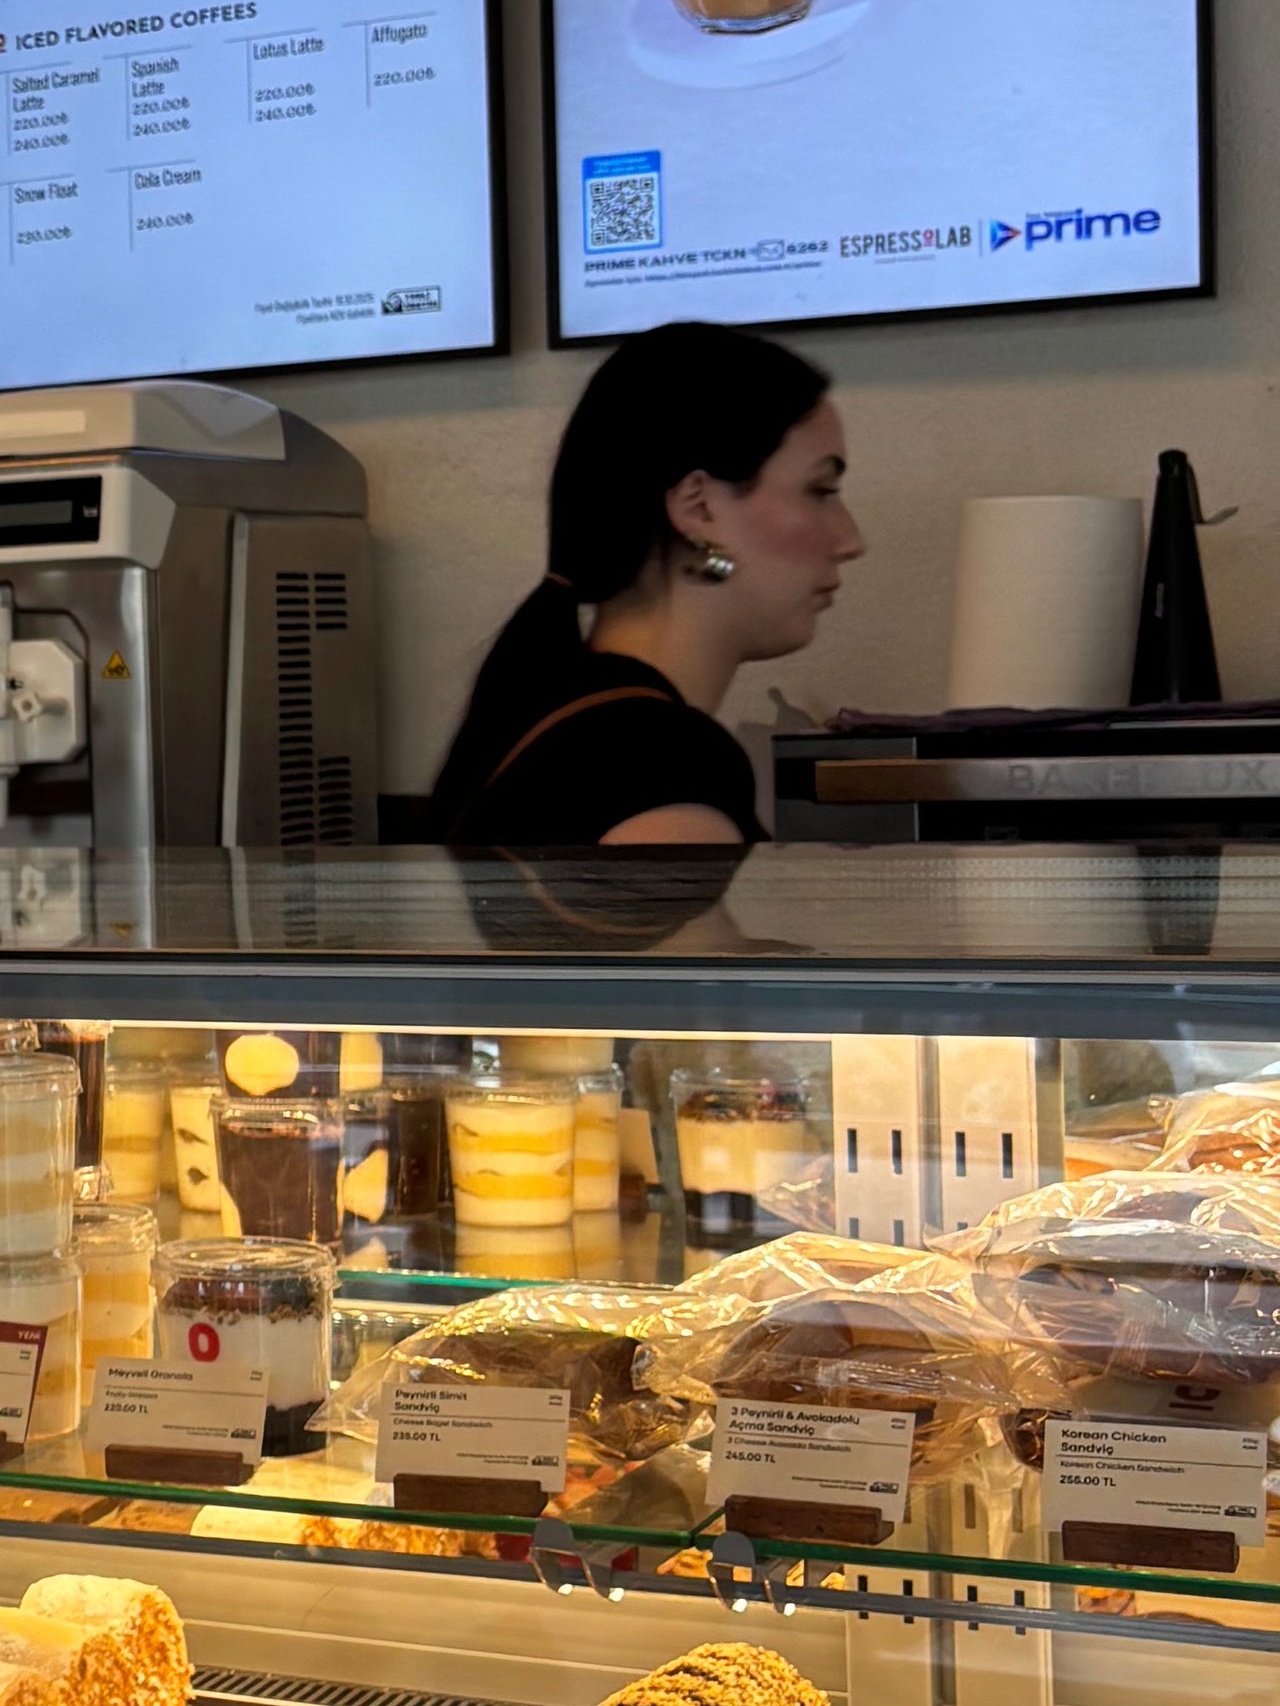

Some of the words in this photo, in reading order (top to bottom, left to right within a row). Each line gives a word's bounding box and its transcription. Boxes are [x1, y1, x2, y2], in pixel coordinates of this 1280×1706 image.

[15, 30, 60, 50] ICED
[65, 15, 164, 44] FLAVORED
[170, 1, 258, 30] COFFEES
[1025, 208, 1160, 251] prime
[585, 259, 635, 272] PRIME
[639, 254, 697, 268] KAHVE
[740, 1407, 784, 1420] Peynirli
[796, 1412, 860, 1425] Avokadolu
[430, 1432, 441, 1442] TL
[1061, 1429, 1109, 1441] Korean
[1111, 1431, 1167, 1444] Chicken
[764, 1452, 776, 1463] TL
[1060, 1460, 1094, 1470] Korean
[1095, 1462, 1135, 1472] Chicken
[1102, 1477, 1117, 1487] TL
